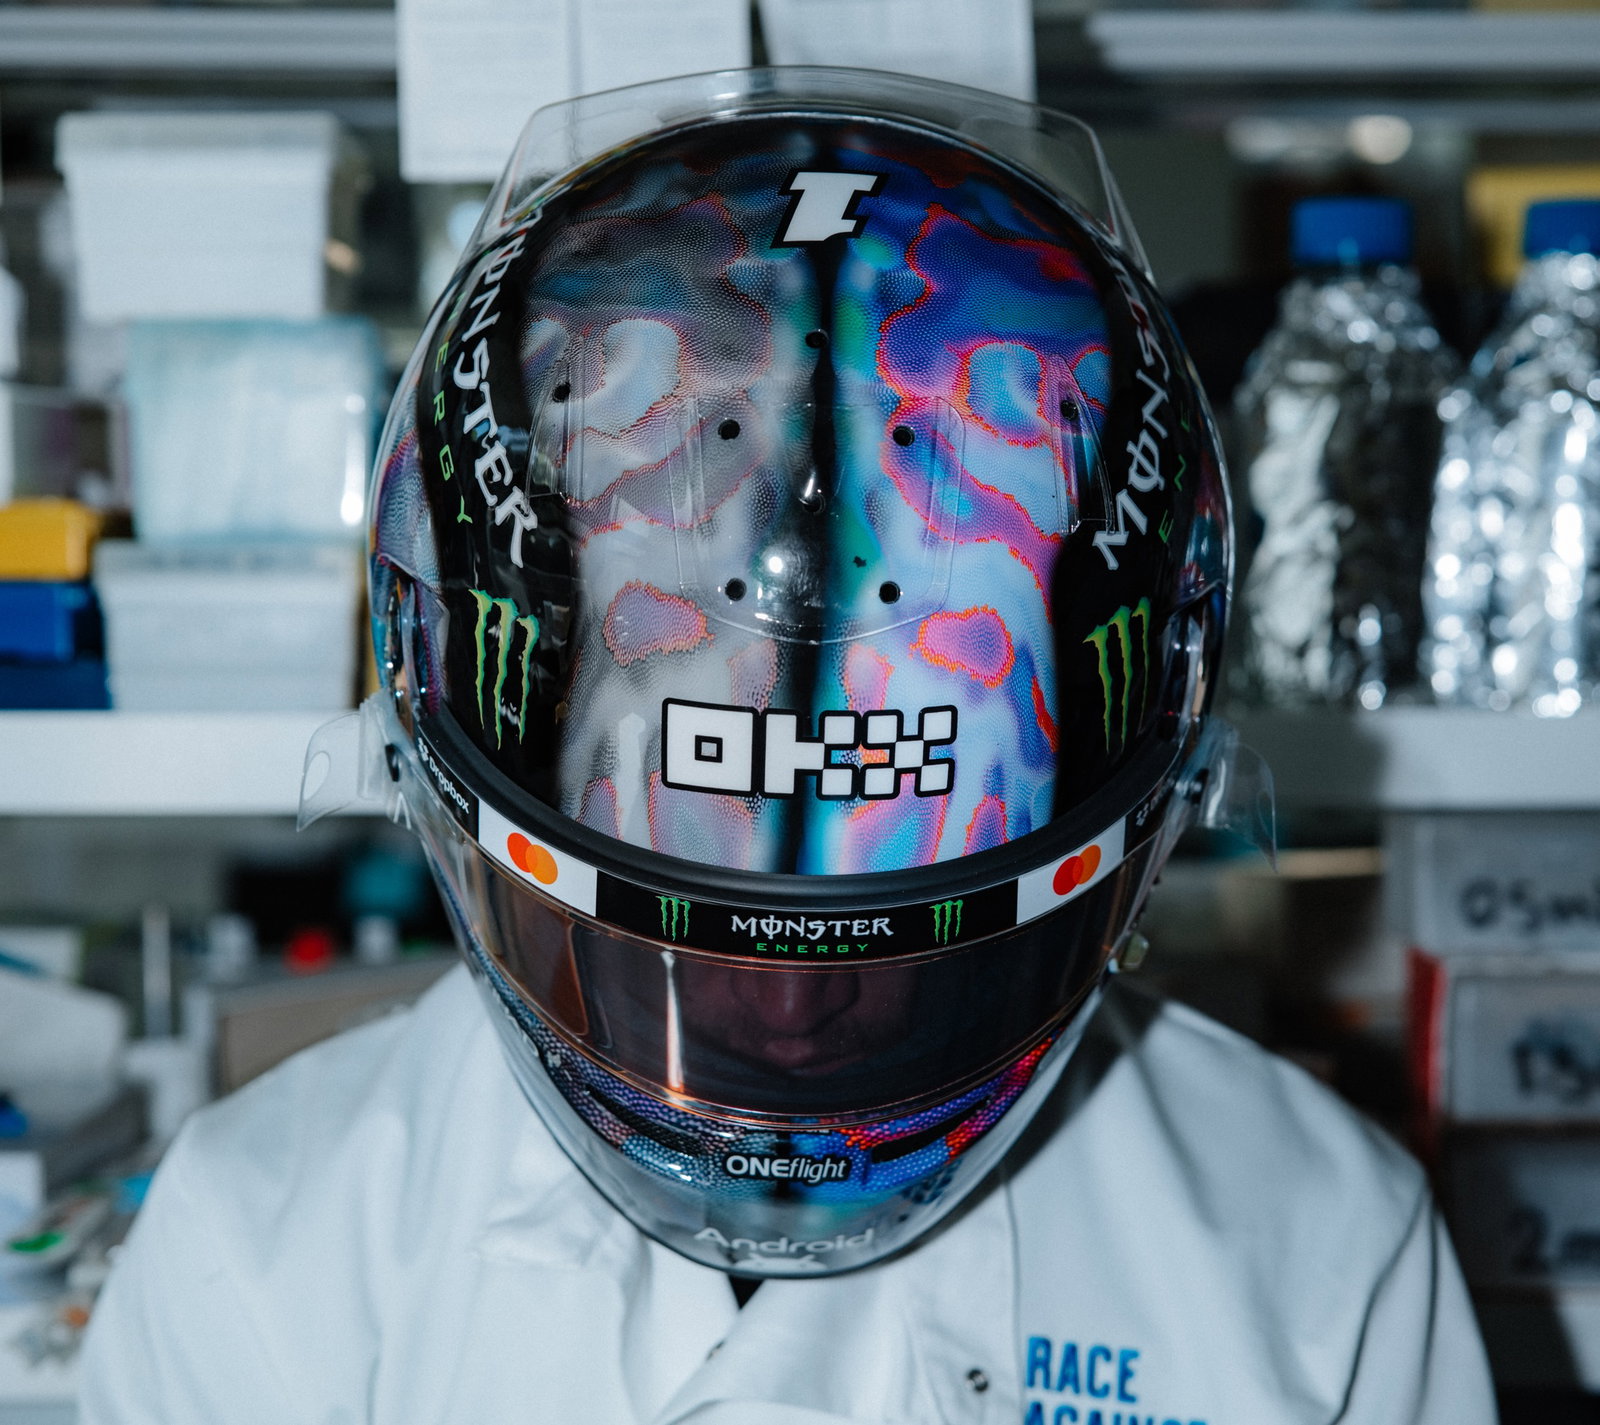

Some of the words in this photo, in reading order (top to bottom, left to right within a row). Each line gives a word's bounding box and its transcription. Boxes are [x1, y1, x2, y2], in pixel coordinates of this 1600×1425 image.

[662, 698, 957, 799] OKX
[429, 756, 470, 814] Dropbox
[730, 914, 894, 940] MONSTER
[756, 942, 869, 953] ENERGY
[726, 1154, 848, 1183] ONEflight
[694, 1227, 875, 1253] Android
[1026, 1336, 1140, 1403] RACE
